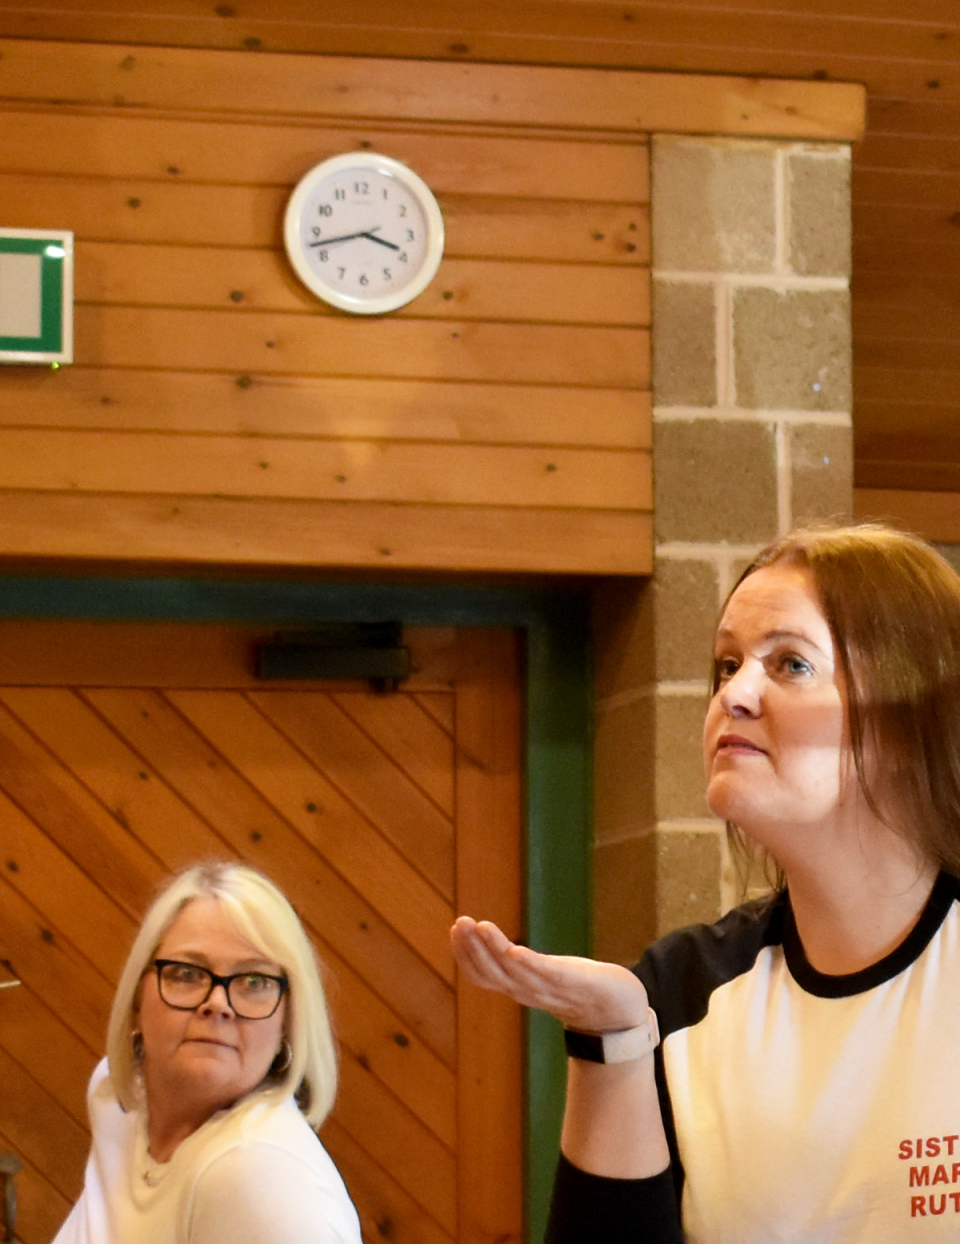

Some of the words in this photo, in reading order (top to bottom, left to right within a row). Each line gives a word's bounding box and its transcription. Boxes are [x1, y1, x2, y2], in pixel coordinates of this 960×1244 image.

[335, 189, 346, 200] 11
[354, 183, 369, 195] 12
[383, 190, 389, 200] 1
[319, 205, 333, 217] 10
[399, 206, 407, 218] 2
[312, 227, 321, 238] 9
[407, 230, 415, 241] 3
[319, 250, 329, 262] 8
[398, 252, 408, 262] 4
[337, 267, 346, 279] 7
[383, 269, 392, 280] 5
[360, 273, 369, 286] 6
